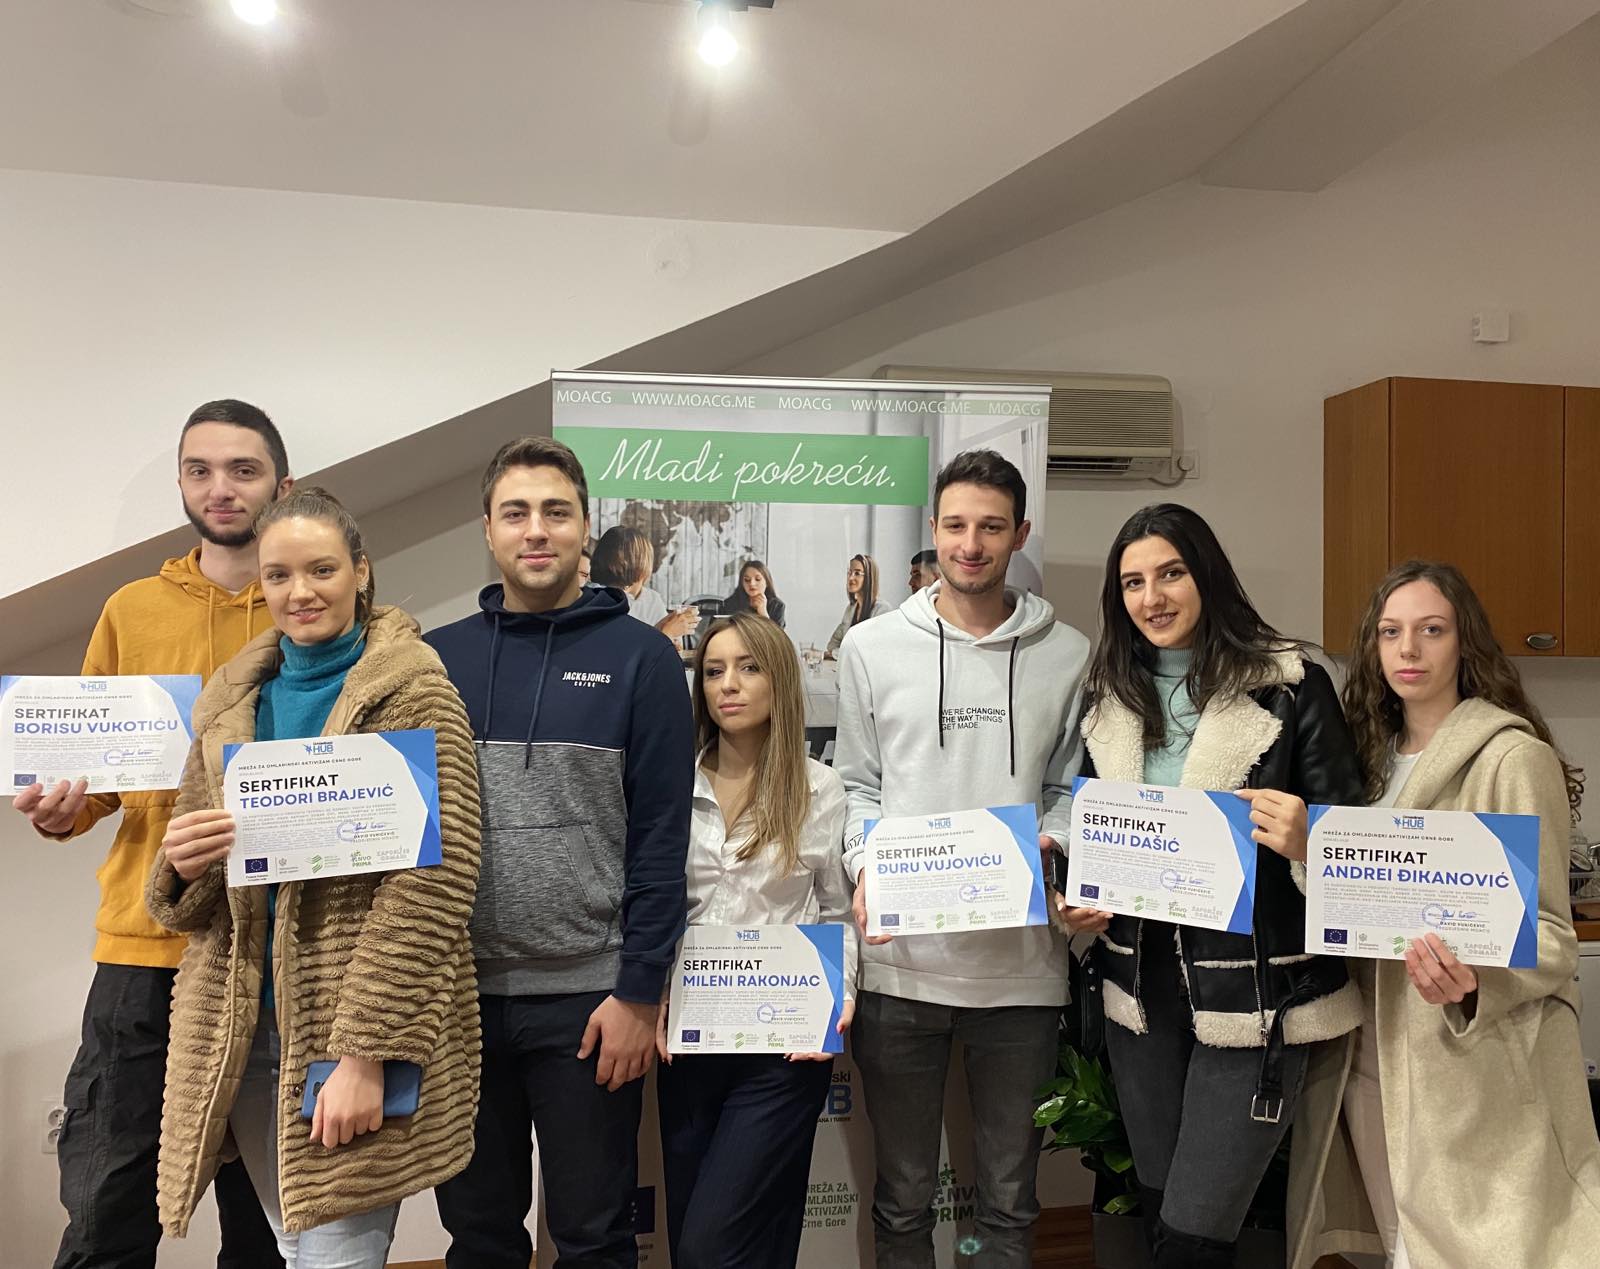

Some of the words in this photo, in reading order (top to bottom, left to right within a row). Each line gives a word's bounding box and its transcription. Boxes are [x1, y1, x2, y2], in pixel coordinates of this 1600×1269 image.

[556, 390, 612, 404] MOACG
[632, 391, 756, 408] WWW.MOACG.ME
[778, 397, 832, 411] MOACG
[851, 399, 971, 414] WWW.MOACG.ME
[988, 402, 1040, 416] MOACG
[599, 438, 723, 482] Mladi
[731, 441, 896, 499] pokreću.
[562, 672, 611, 684] JACK&JONES
[14, 708, 110, 719] SERTIFIKAT
[966, 708, 1006, 716] CHANGING
[975, 714, 1003, 723] THINGS
[14, 722, 82, 734] BORISU
[88, 717, 178, 733] VUKOTIĆU
[313, 744, 334, 753] HUB
[239, 774, 339, 793] SERTIFIKAT
[240, 793, 312, 809] TEODORI
[318, 784, 394, 803] BRAJEVIĆ
[1083, 812, 1166, 834] SERTIFIKAT
[1403, 820, 1424, 828] HUB
[1082, 828, 1125, 845] SANJI
[1130, 834, 1180, 853] DAŠIĆ
[877, 845, 956, 860] SERTIFIKAT
[1323, 846, 1428, 865] SERTIFIKAT
[877, 861, 919, 875] ĐURU
[924, 853, 1002, 871] VUJOVIĆU
[1322, 864, 1392, 882] ANDREI
[1397, 869, 1509, 889] ĐIKANOVIĆ
[683, 960, 762, 971] SERTIFIKAT
[683, 975, 733, 987] MILENI
[738, 975, 820, 987] RAKONJAC
[808, 1182, 833, 1193] REŽA
[837, 1183, 848, 1192] ZA
[947, 1186, 974, 1202] NV
[808, 1193, 858, 1205] MLADINSKI
[934, 1205, 974, 1222] RIM
[825, 1218, 846, 1227] Gore
